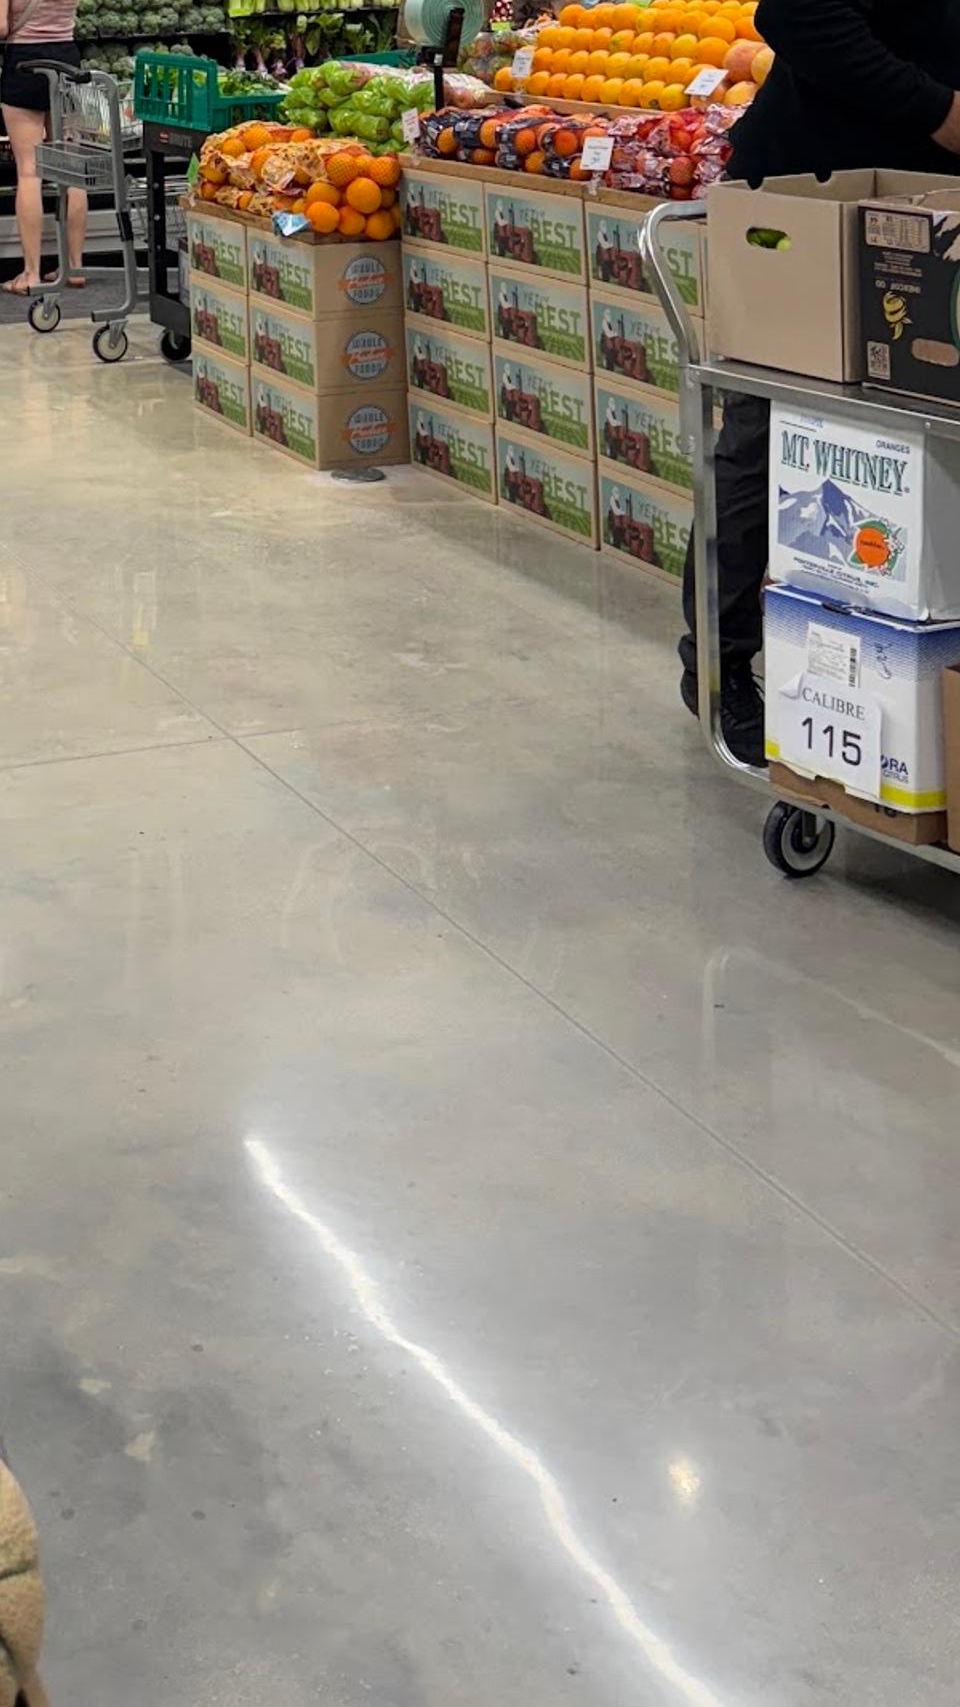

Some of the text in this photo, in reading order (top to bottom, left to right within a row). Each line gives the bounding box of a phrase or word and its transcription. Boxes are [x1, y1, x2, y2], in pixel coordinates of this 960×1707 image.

[439, 201, 478, 229] BEST
[530, 218, 576, 249] BEST
[278, 260, 309, 289] BEST
[441, 277, 481, 309] BEST
[535, 302, 581, 335] BEST
[280, 333, 312, 361] BEST
[644, 332, 679, 363] BES
[445, 356, 485, 390] BEST
[282, 405, 313, 434] BEST
[538, 385, 584, 424] BEST
[447, 431, 488, 468] BEST
[648, 424, 683, 457] BES
[876, 439, 911, 454] ORANGES
[781, 430, 908, 493] MT. WHITNEY
[542, 469, 587, 512] BEST
[652, 515, 690, 549] BES
[803, 687, 865, 721] CALIBRE
[802, 717, 862, 766] 115
